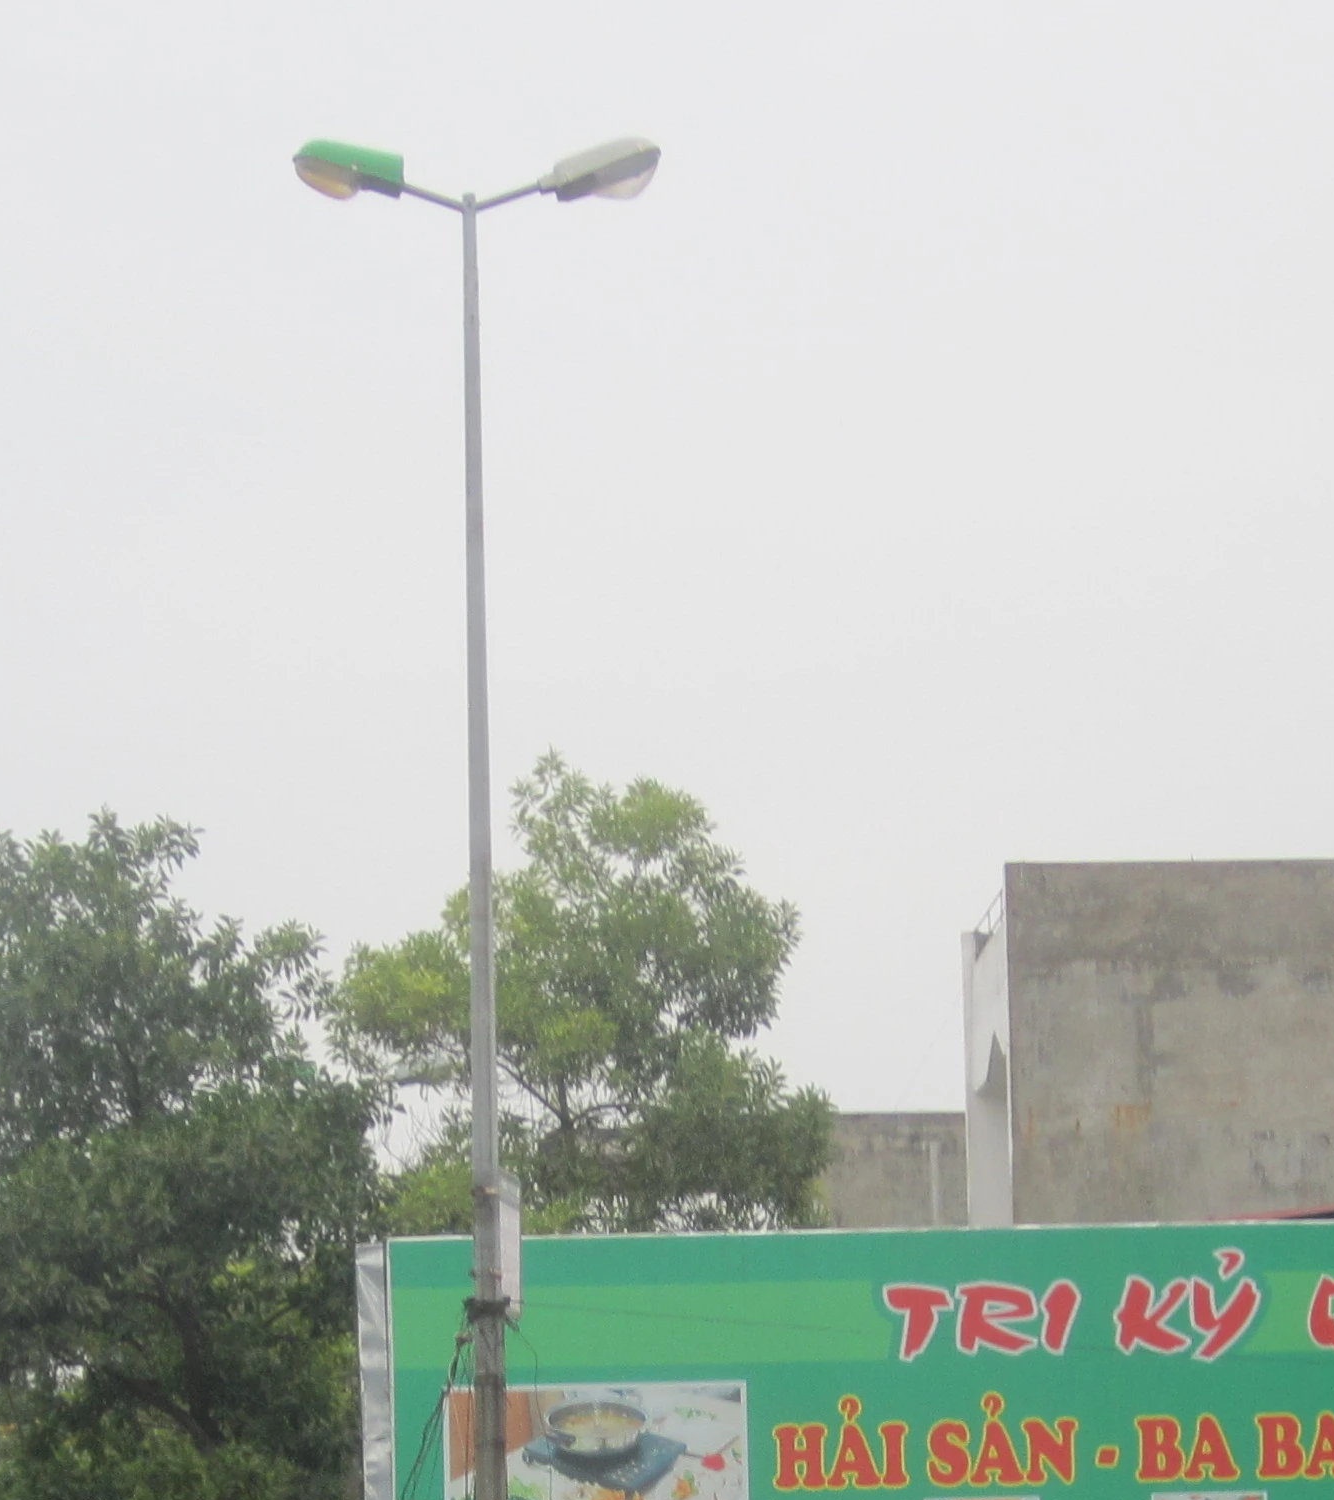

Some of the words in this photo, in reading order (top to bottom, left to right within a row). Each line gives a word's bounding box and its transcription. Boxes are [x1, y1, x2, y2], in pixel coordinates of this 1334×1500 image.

[884, 1280, 1081, 1361] TRI
[1114, 1248, 1261, 1361] KỶ
[773, 1392, 910, 1489] HẢI
[927, 1391, 1079, 1486] SẢN
[1136, 1414, 1240, 1483] BA
